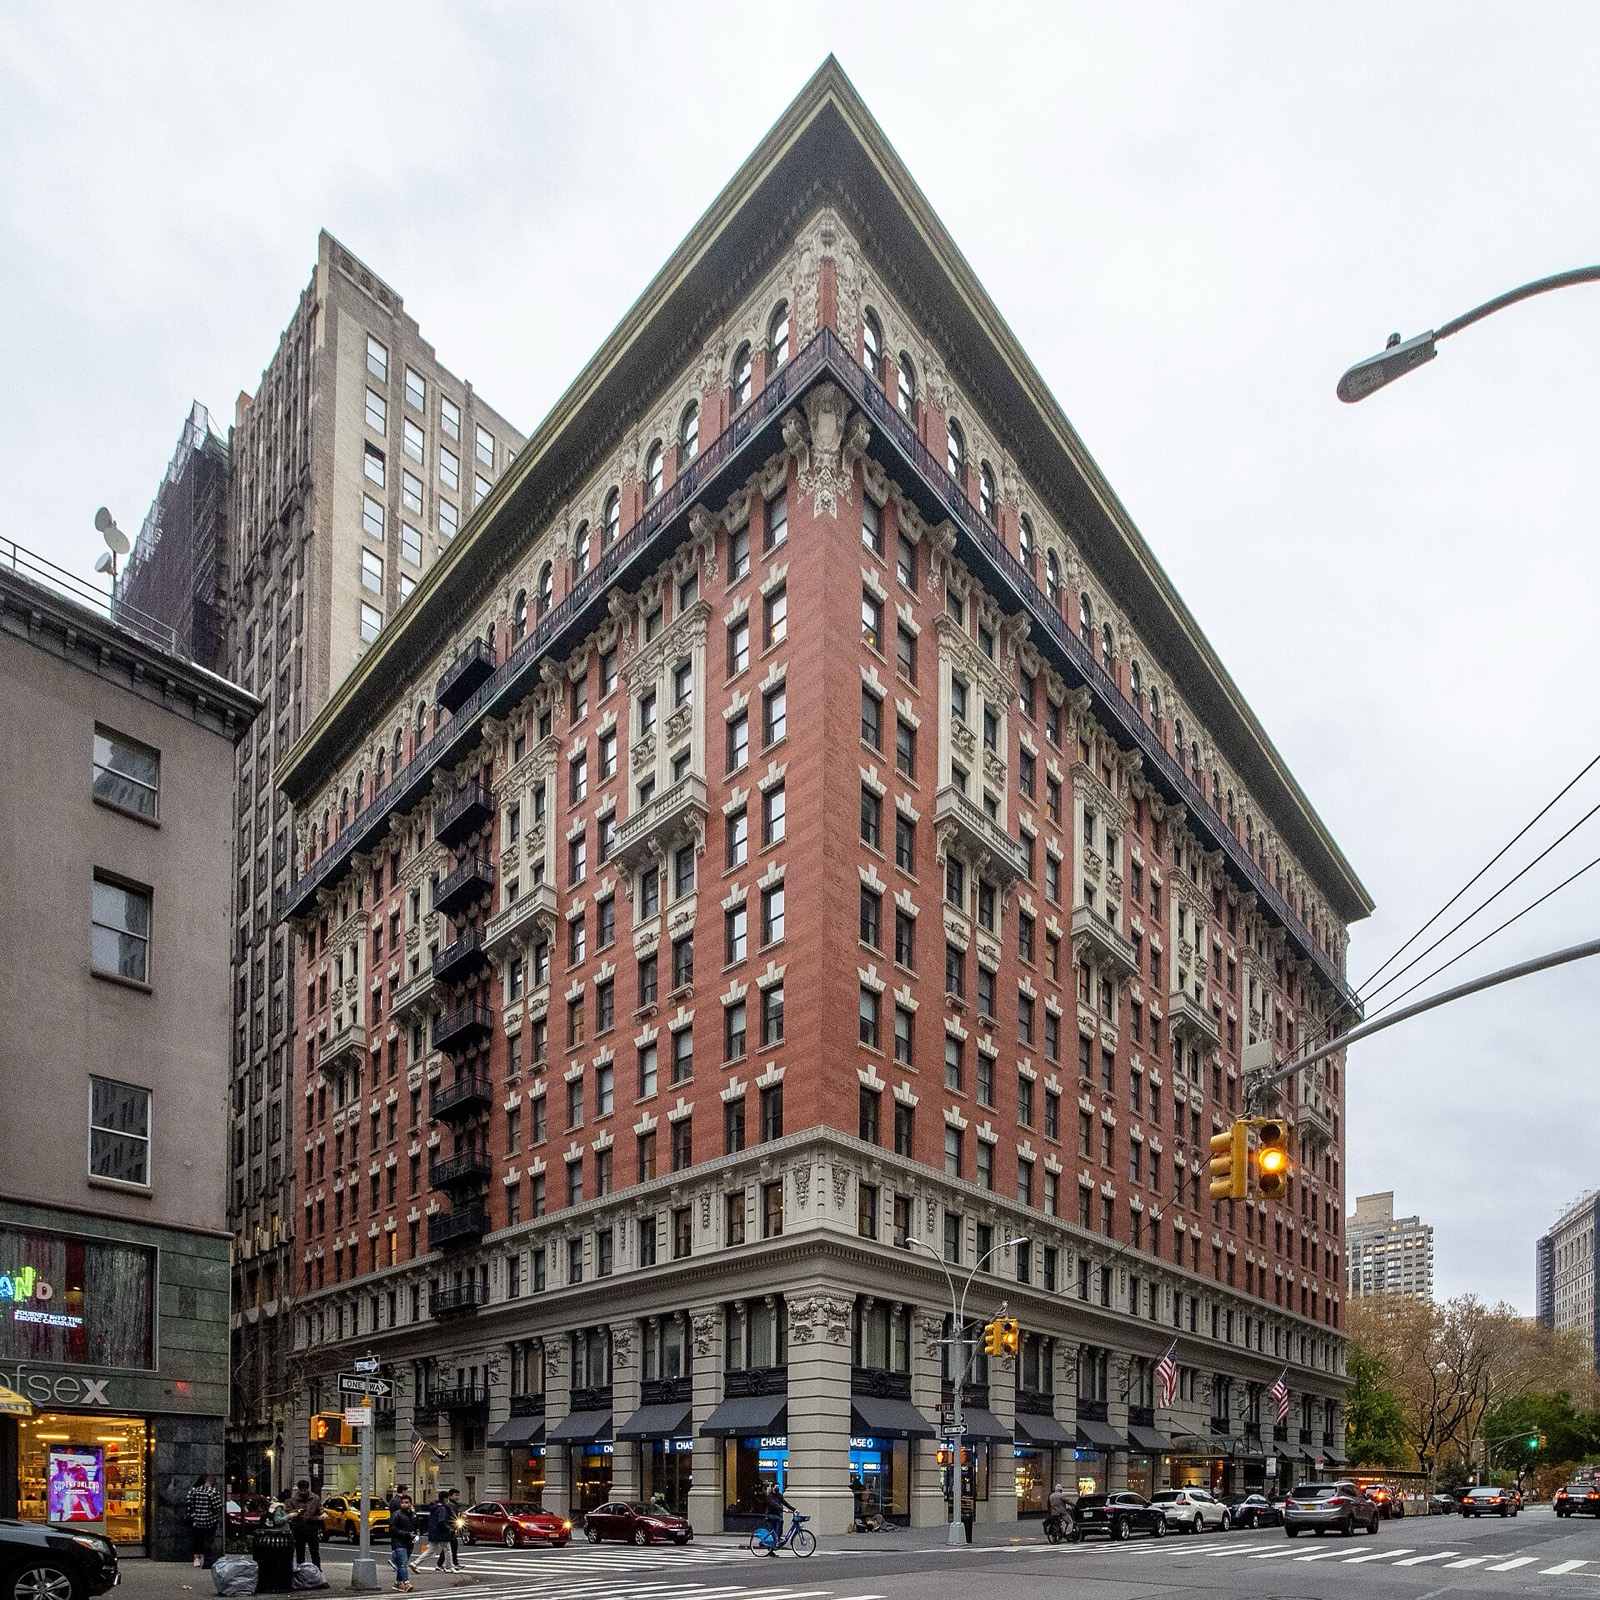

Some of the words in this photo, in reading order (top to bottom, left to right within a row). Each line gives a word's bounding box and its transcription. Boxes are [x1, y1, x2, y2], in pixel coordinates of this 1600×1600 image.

[347, 1380, 363, 1389] ONE
[369, 1383, 385, 1392] WAY
[760, 1437, 787, 1447] CHASE
